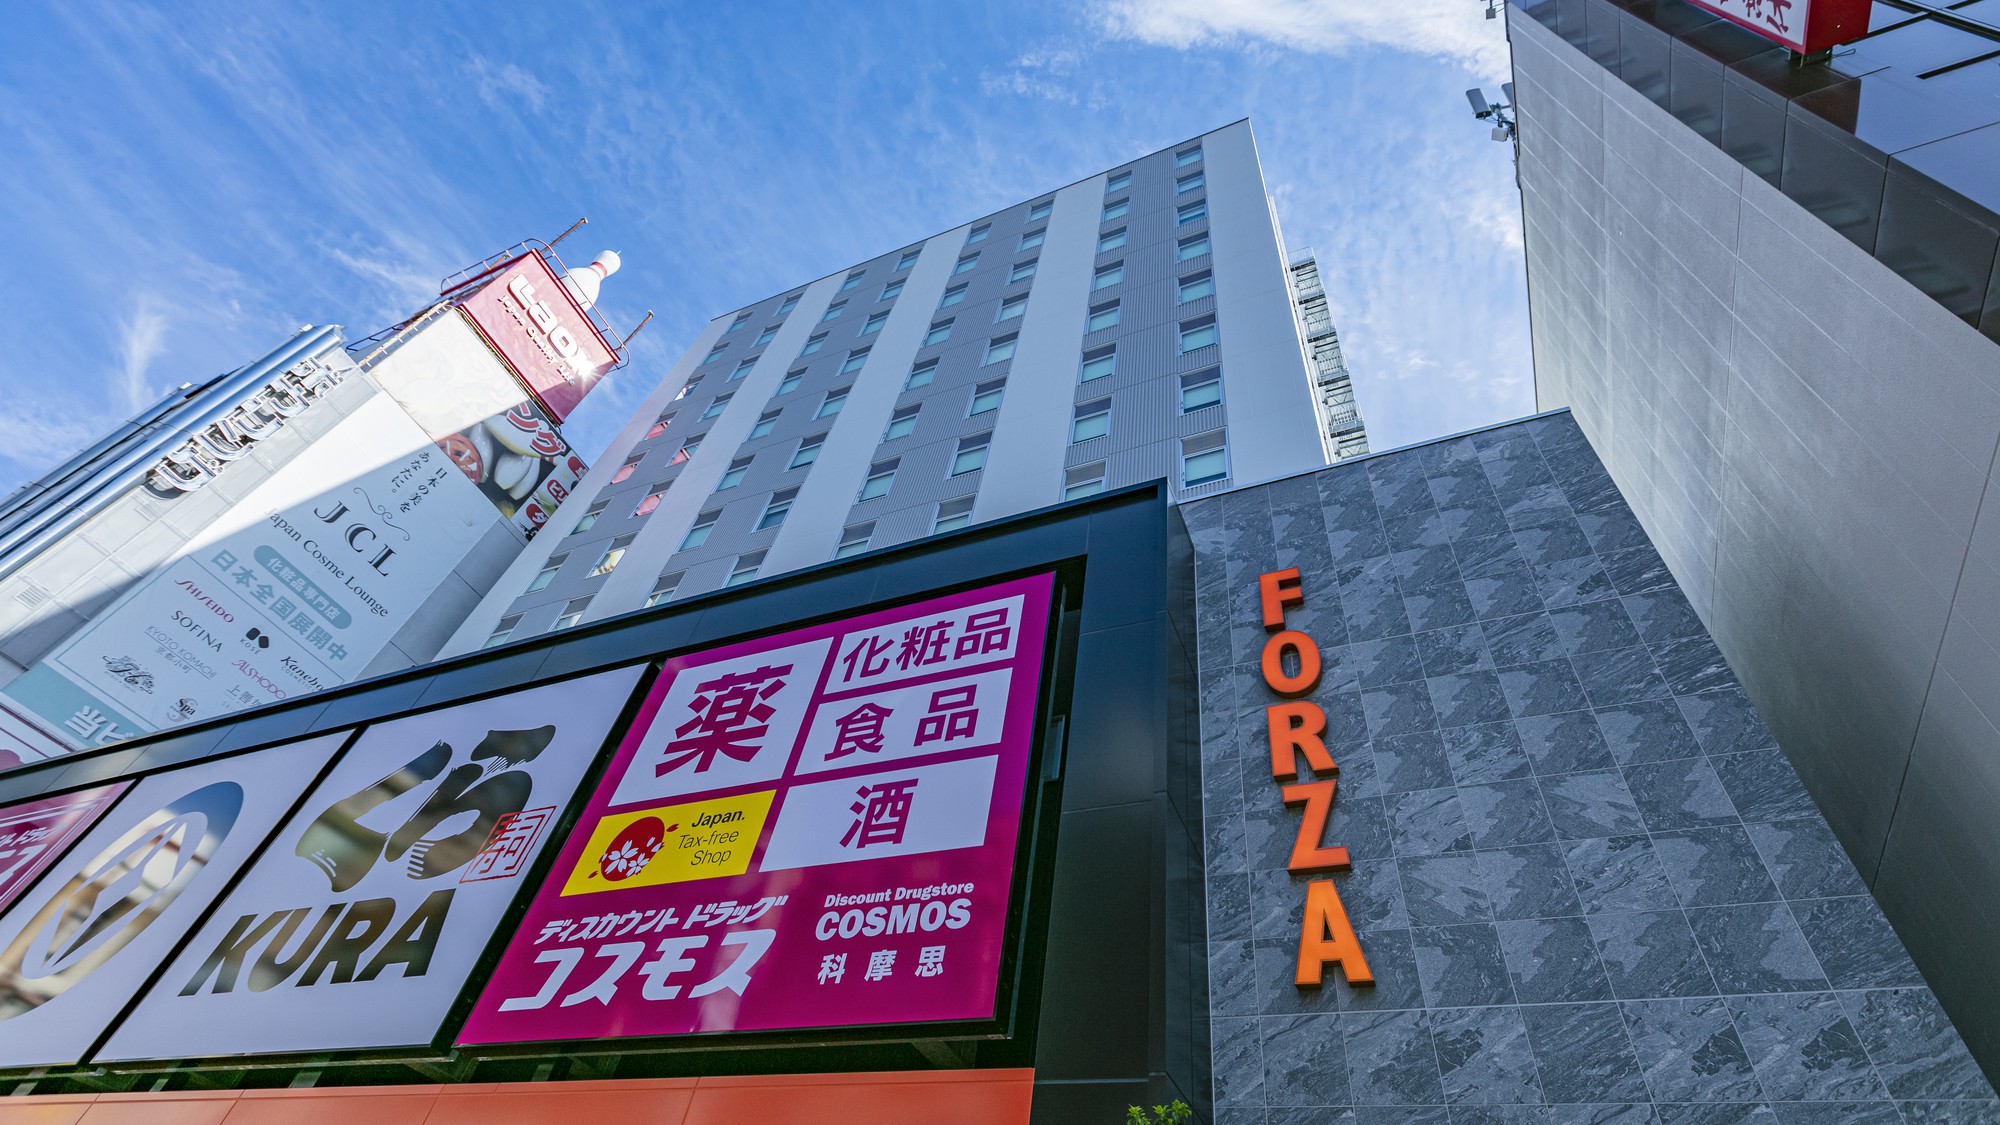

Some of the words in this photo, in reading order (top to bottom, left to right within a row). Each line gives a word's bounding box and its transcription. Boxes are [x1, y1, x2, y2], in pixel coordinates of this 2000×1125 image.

[400, 467, 448, 514] 日本の美を
[264, 508, 302, 542] Japan
[303, 540, 345, 579] Cosme
[345, 576, 389, 618] Lounge
[266, 557, 341, 620] 化粧品専門店
[174, 579, 234, 623] SHISEIDO
[211, 549, 348, 662] 日本全国展開中
[146, 625, 179, 650] KYOTO
[178, 648, 217, 679] KOMACHI
[171, 610, 223, 653] SOFINA
[843, 607, 1011, 683] 化粧品
[280, 656, 324, 692] Kanebo
[177, 698, 196, 716] Spa
[655, 663, 794, 779] 薬
[824, 684, 980, 762] 食品
[1258, 567, 1376, 990] FORZA
[295, 724, 556, 892] くら
[691, 809, 745, 830] Japan.
[839, 778, 919, 850] 酒
[678, 829, 740, 850] Tax-free
[690, 849, 732, 867] Shop
[533, 907, 679, 945] ディスカウント
[682, 895, 789, 930] ドラッグ
[815, 898, 972, 941] COSMOS
[824, 889, 892, 908] Discount
[894, 882, 975, 901] Drugstore
[178, 888, 456, 998] KURA
[497, 929, 777, 1012] コスモス
